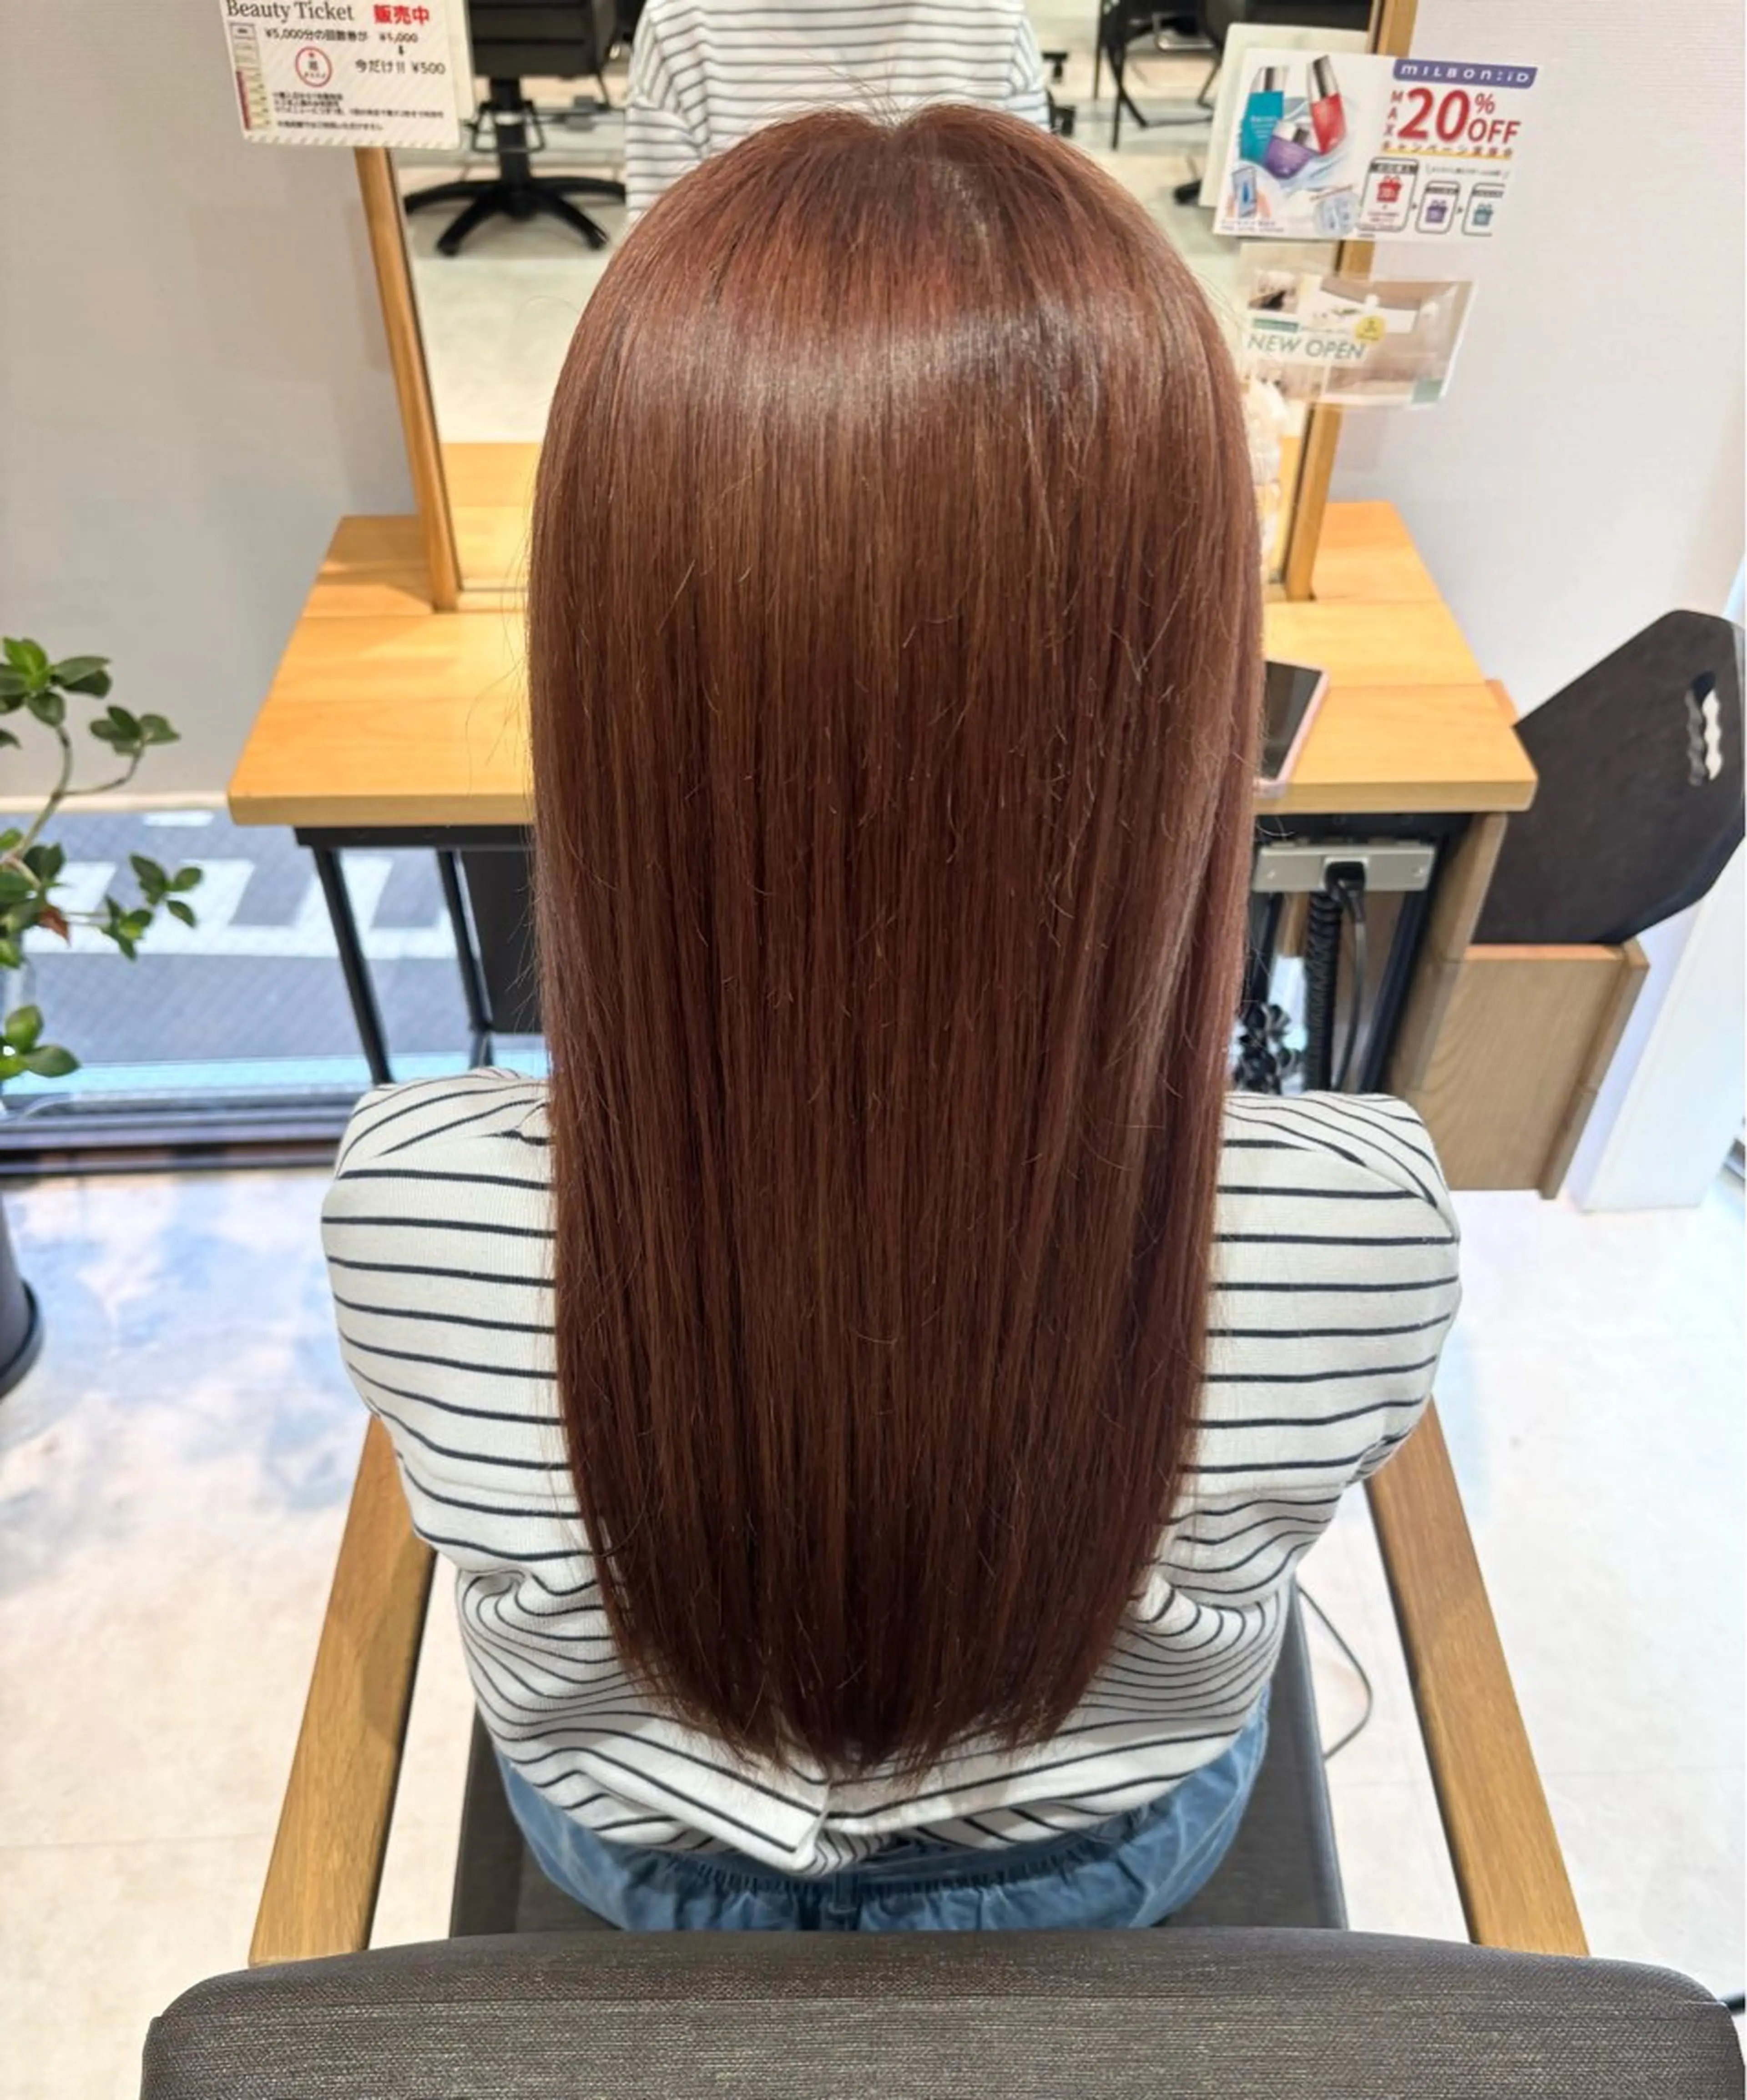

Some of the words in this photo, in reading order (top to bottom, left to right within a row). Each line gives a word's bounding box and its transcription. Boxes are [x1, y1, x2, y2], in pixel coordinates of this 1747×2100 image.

[227, 0, 290, 23] Beauty
[294, 0, 354, 21] Ticket
[373, 4, 429, 25] 販売中
[411, 61, 446, 75] ¥500
[1467, 118, 1521, 144] OFF
[1247, 333, 1302, 353] NEW
[1305, 339, 1366, 359] OPEN
